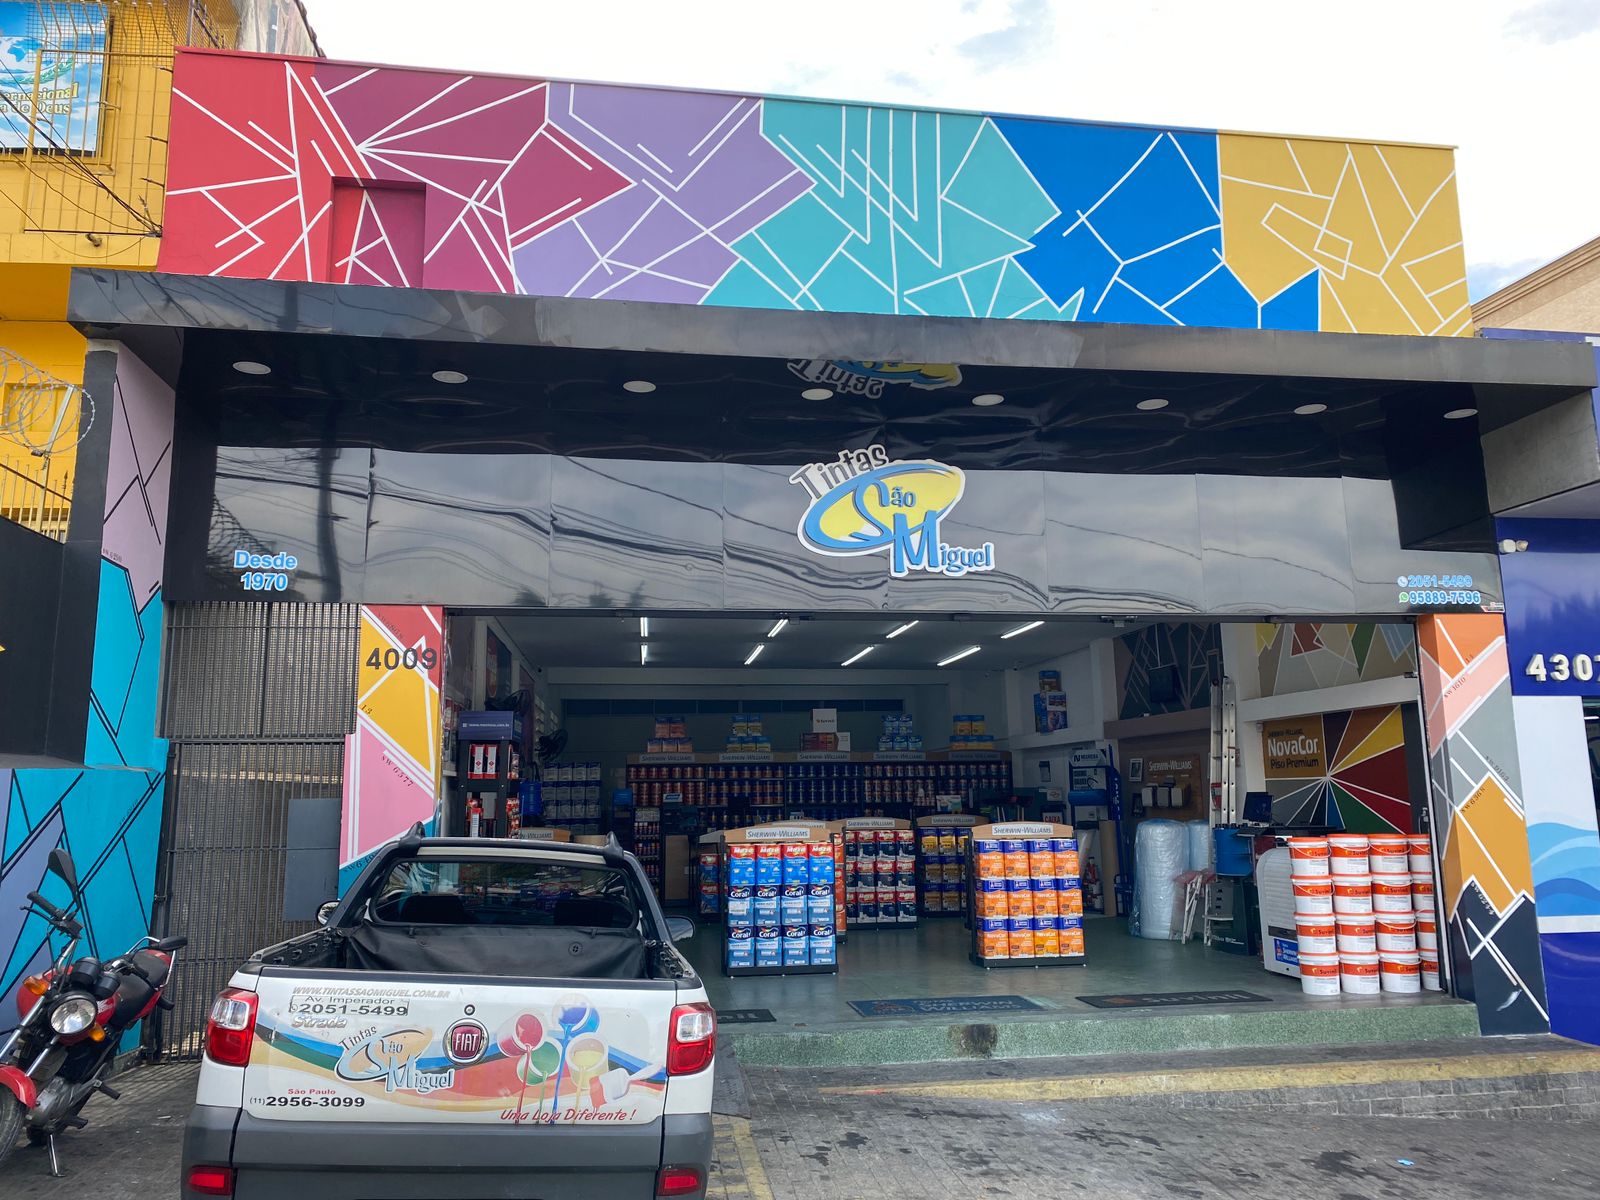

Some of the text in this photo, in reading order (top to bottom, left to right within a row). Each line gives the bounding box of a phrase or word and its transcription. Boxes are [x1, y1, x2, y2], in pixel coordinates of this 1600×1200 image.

[790, 445, 888, 500] Tintas
[893, 509, 992, 574] Miguel
[234, 550, 297, 570] Desde
[240, 572, 288, 591] 1970
[1409, 591, 1481, 605] 95889-7596
[366, 647, 438, 670] 4009
[1268, 735, 1319, 757] NovaCor
[1271, 758, 1319, 769] Piso Premium
[747, 830, 808, 838] SHERWIN-WILLIAMS
[993, 826, 1052, 835] SHERWIN-WILLIAMS
[292, 986, 452, 999] WWW.TINTASSAOMIGUEL.COM.BR
[329, 996, 396, 1005] Imperador
[299, 1003, 408, 1016] 2051-5499
[292, 1015, 348, 1029] Strada
[339, 1026, 377, 1050] Tintas
[456, 1033, 480, 1052] FIAT
[386, 1056, 454, 1092] Miguel
[249, 1096, 365, 1107] (11) 2956-3099
[500, 1108, 528, 1121] Uma
[534, 1109, 561, 1122] Loja
[563, 1108, 627, 1121] Diferente
